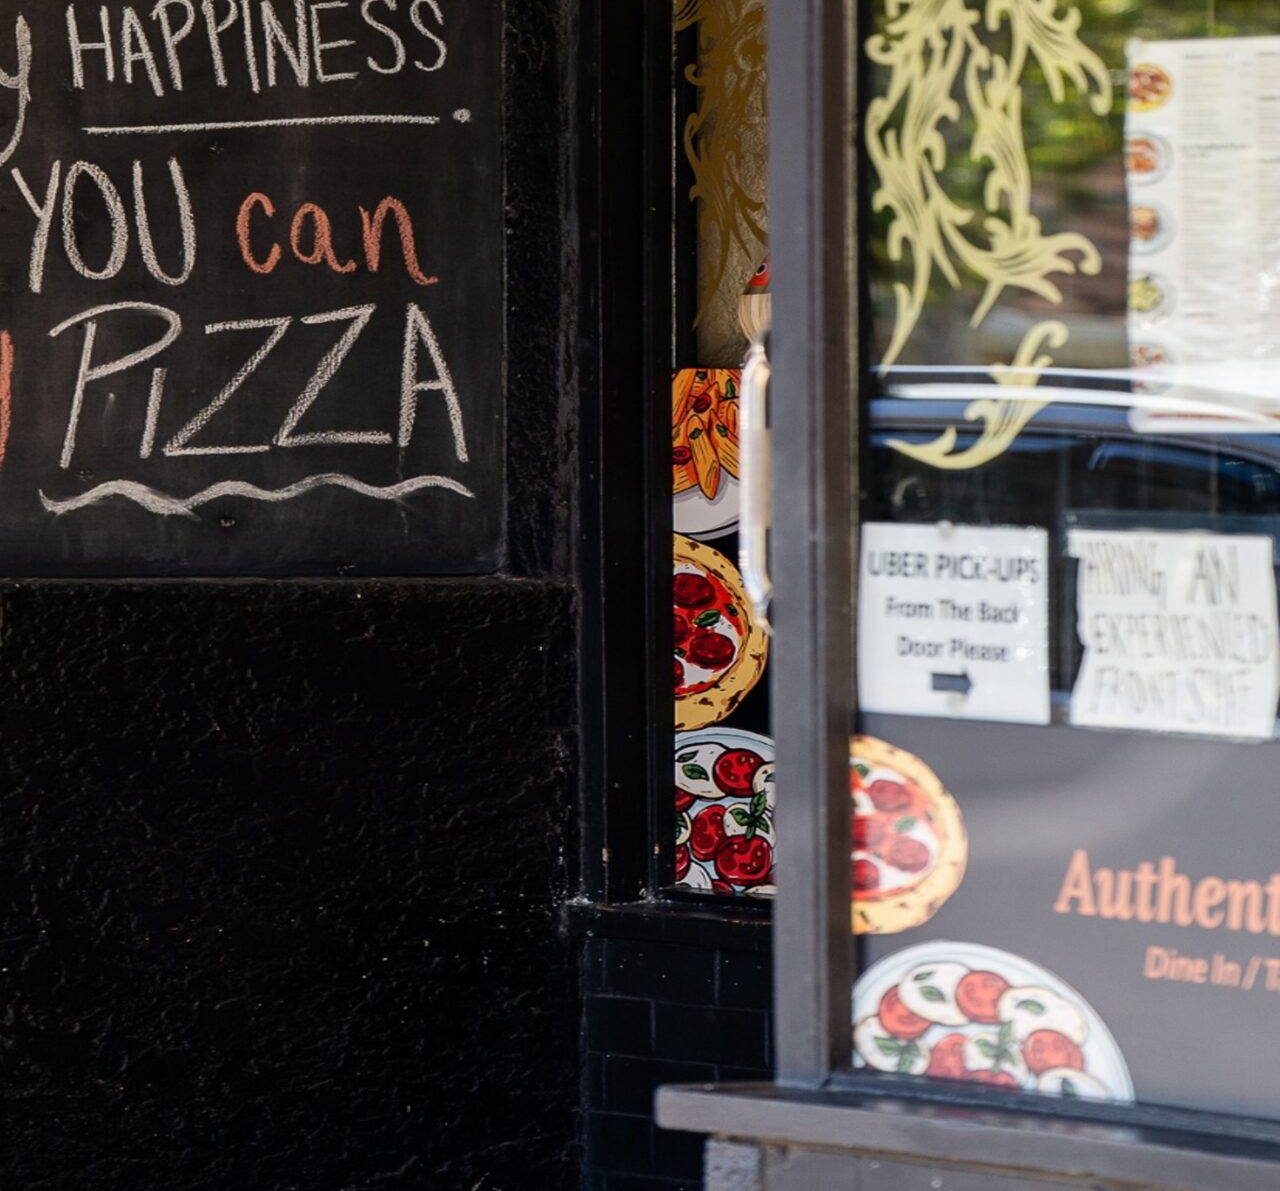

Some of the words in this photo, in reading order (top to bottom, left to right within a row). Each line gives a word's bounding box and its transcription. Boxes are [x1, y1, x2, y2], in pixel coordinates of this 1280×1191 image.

[11, 157, 197, 294] YOU
[236, 191, 440, 286] can
[868, 551, 928, 578] UBER
[1186, 544, 1241, 606] AN
[885, 596, 932, 618] From
[938, 599, 972, 621] The
[896, 635, 942, 657] Door
[950, 639, 1009, 662] Please
[1143, 945, 1209, 984] Dine
[1211, 953, 1241, 986] In
